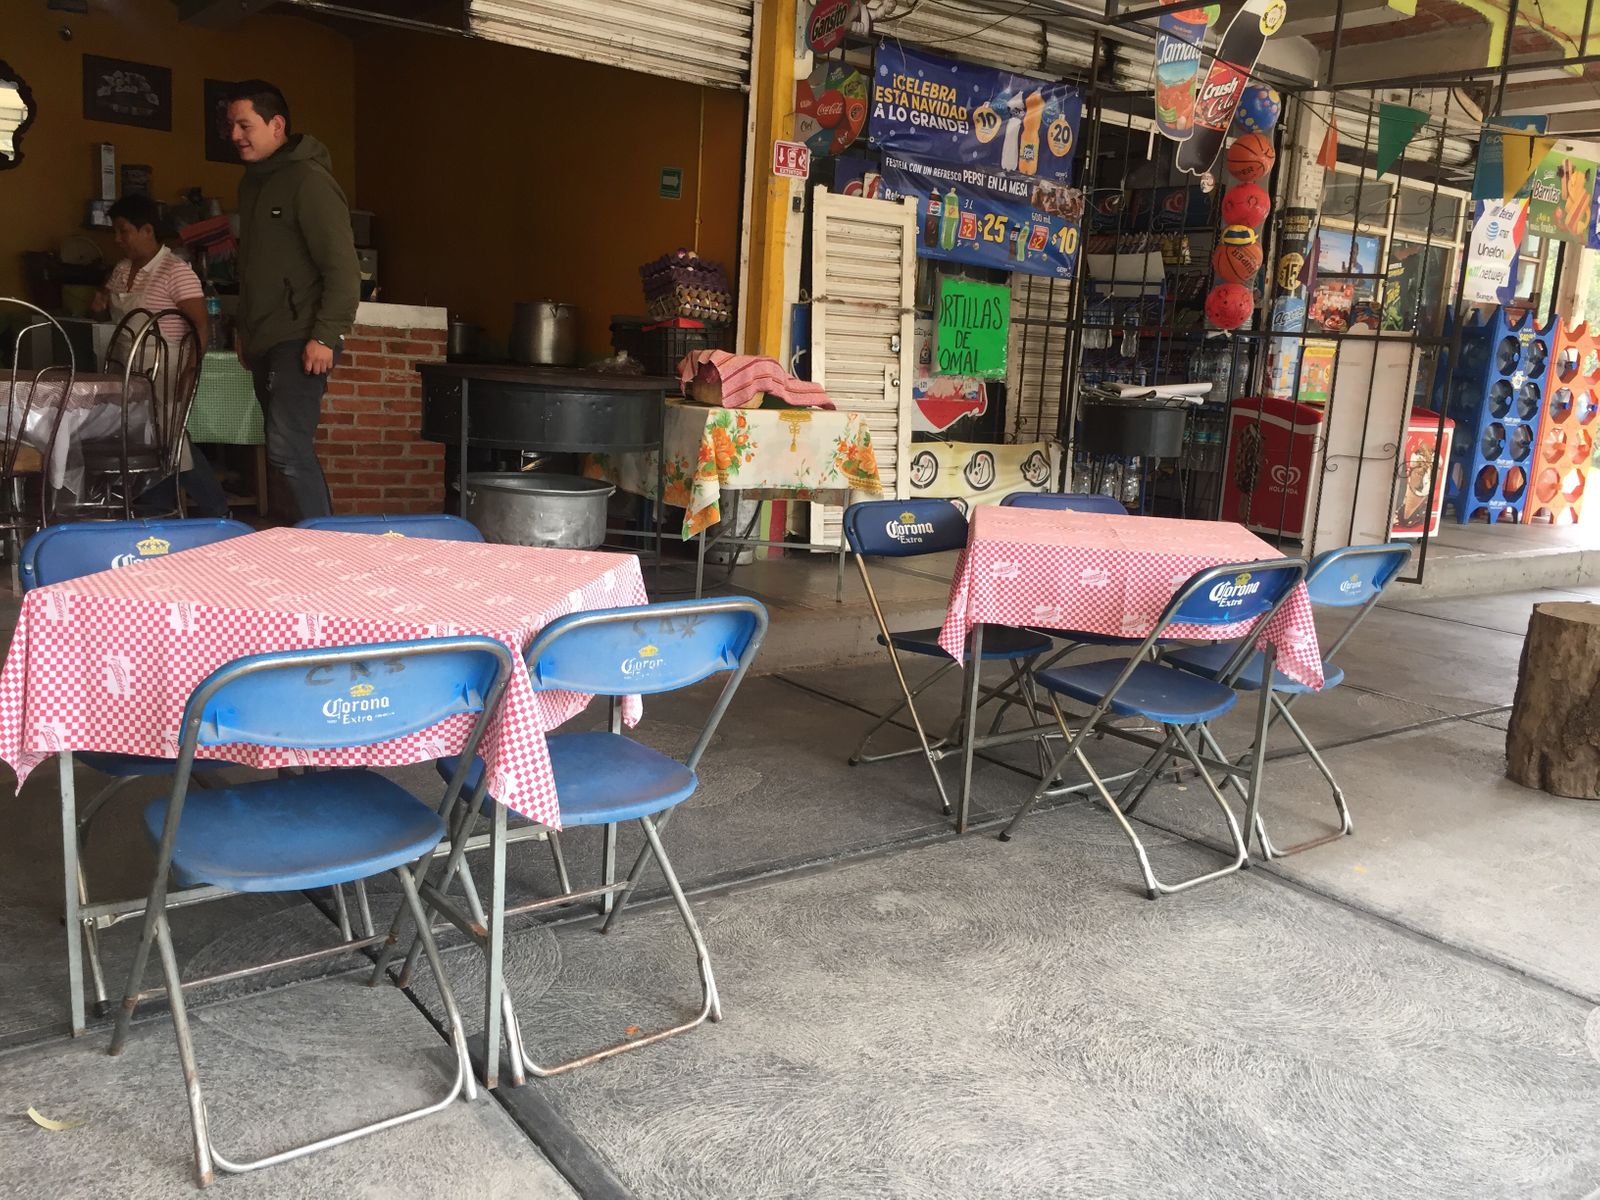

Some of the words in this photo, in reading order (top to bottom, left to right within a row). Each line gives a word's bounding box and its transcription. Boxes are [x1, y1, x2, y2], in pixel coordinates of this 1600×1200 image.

[812, 3, 848, 41] Gansito
[893, 73, 957, 103] ¡CELEBRA
[1203, 76, 1239, 100] Crush
[875, 85, 909, 108] ESTA
[911, 94, 968, 120] NAVIDAD
[873, 102, 885, 119] A
[888, 104, 907, 122] LO
[909, 110, 969, 135] GRANDE!
[1051, 124, 1071, 144] $20
[909, 163, 922, 173] CON
[923, 165, 933, 176] UN
[932, 167, 962, 182] REFRESCO
[962, 169, 984, 187] PEPSI
[987, 175, 998, 190] EN
[999, 178, 1008, 192] LA
[1008, 181, 1029, 198] MESA
[963, 198, 969, 209] 3
[977, 213, 1009, 243] $25
[1051, 226, 1078, 255] $10
[1477, 242, 1505, 259] Unefon
[954, 329, 972, 350] DE
[885, 520, 934, 539] Corona
[899, 536, 923, 544] Extra
[1208, 581, 1260, 602] Corona
[1218, 597, 1243, 608] Extra
[322, 696, 390, 719] Corona
[342, 713, 373, 725] Extra
